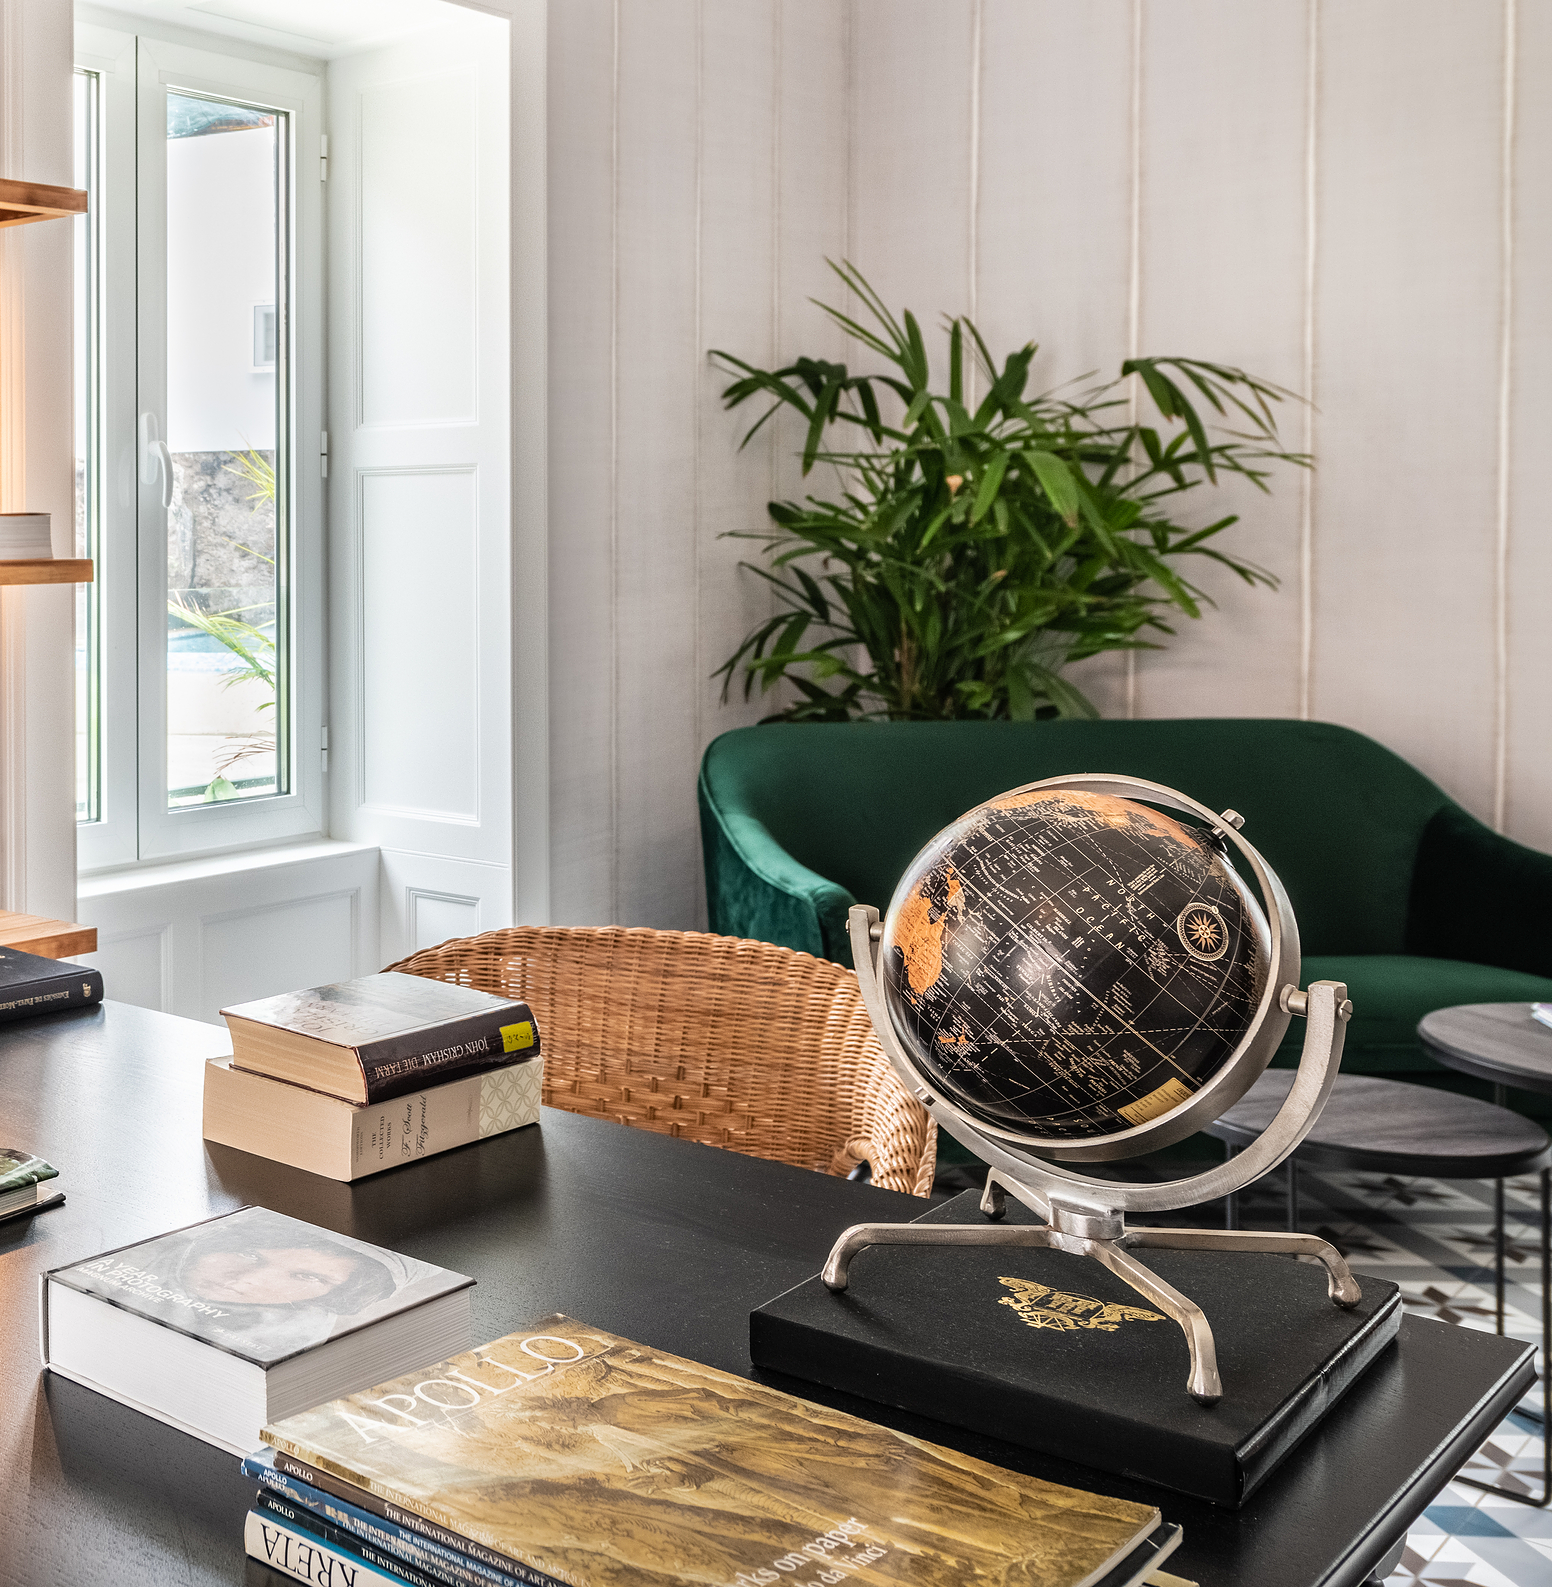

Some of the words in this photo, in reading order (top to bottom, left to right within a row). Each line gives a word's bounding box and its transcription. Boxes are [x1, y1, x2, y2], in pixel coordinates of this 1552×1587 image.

[1082, 886, 1146, 942] PACIFIC
[1106, 879, 1156, 920] NORTH
[1076, 906, 1126, 950] OCEAN
[402, 1056, 418, 1070] DIE
[423, 1045, 464, 1066] GRISHAM
[464, 1036, 489, 1055] JOHN
[374, 1062, 402, 1078] FARM
[402, 1103, 412, 1134] Scott
[415, 1095, 429, 1156] Fitzgerald
[401, 1135, 411, 1157] F.
[76, 1267, 123, 1289] MAGNUM
[120, 1285, 165, 1304] ARCHIVE
[102, 1258, 115, 1266] A
[114, 1262, 159, 1282] YEAR
[86, 1262, 105, 1272] IN
[106, 1269, 230, 1319] PHOTOGRAPHY
[335, 1335, 586, 1445] APOLLO
[272, 1437, 300, 1457] APOLLO
[258, 1474, 285, 1492] APOLLO
[263, 1468, 287, 1485] APOLLO
[284, 1462, 313, 1482] APOLLO
[268, 1500, 295, 1519] APOLLO
[370, 1481, 384, 1494] THE
[385, 1489, 447, 1524] INTERNATIONAL
[508, 1545, 525, 1558] ART
[527, 1554, 545, 1568] AND
[260, 1522, 359, 1587] KRETA
[353, 1517, 368, 1531] THE
[368, 1523, 430, 1561] INTERNATIONAL
[431, 1555, 473, 1582] MAGAZINE
[357, 1528, 412, 1562] INTERNATIONAL
[415, 1558, 454, 1585] MAGAZINE
[361, 1547, 376, 1562] THE
[386, 1508, 402, 1522] THE
[402, 1514, 467, 1553] INTERNATIONAL
[468, 1545, 513, 1573] MAGAZINE
[514, 1566, 527, 1578] OF
[528, 1573, 546, 1587] ART
[399, 1529, 412, 1541] THE
[413, 1535, 465, 1567] INTERNATIONAL
[466, 1561, 503, 1584] MAGAZINE
[504, 1577, 514, 1587] OF
[773, 1551, 811, 1573] on
[801, 1516, 869, 1561] paper
[816, 1568, 848, 1585] da
[833, 1543, 888, 1571] Vinci
